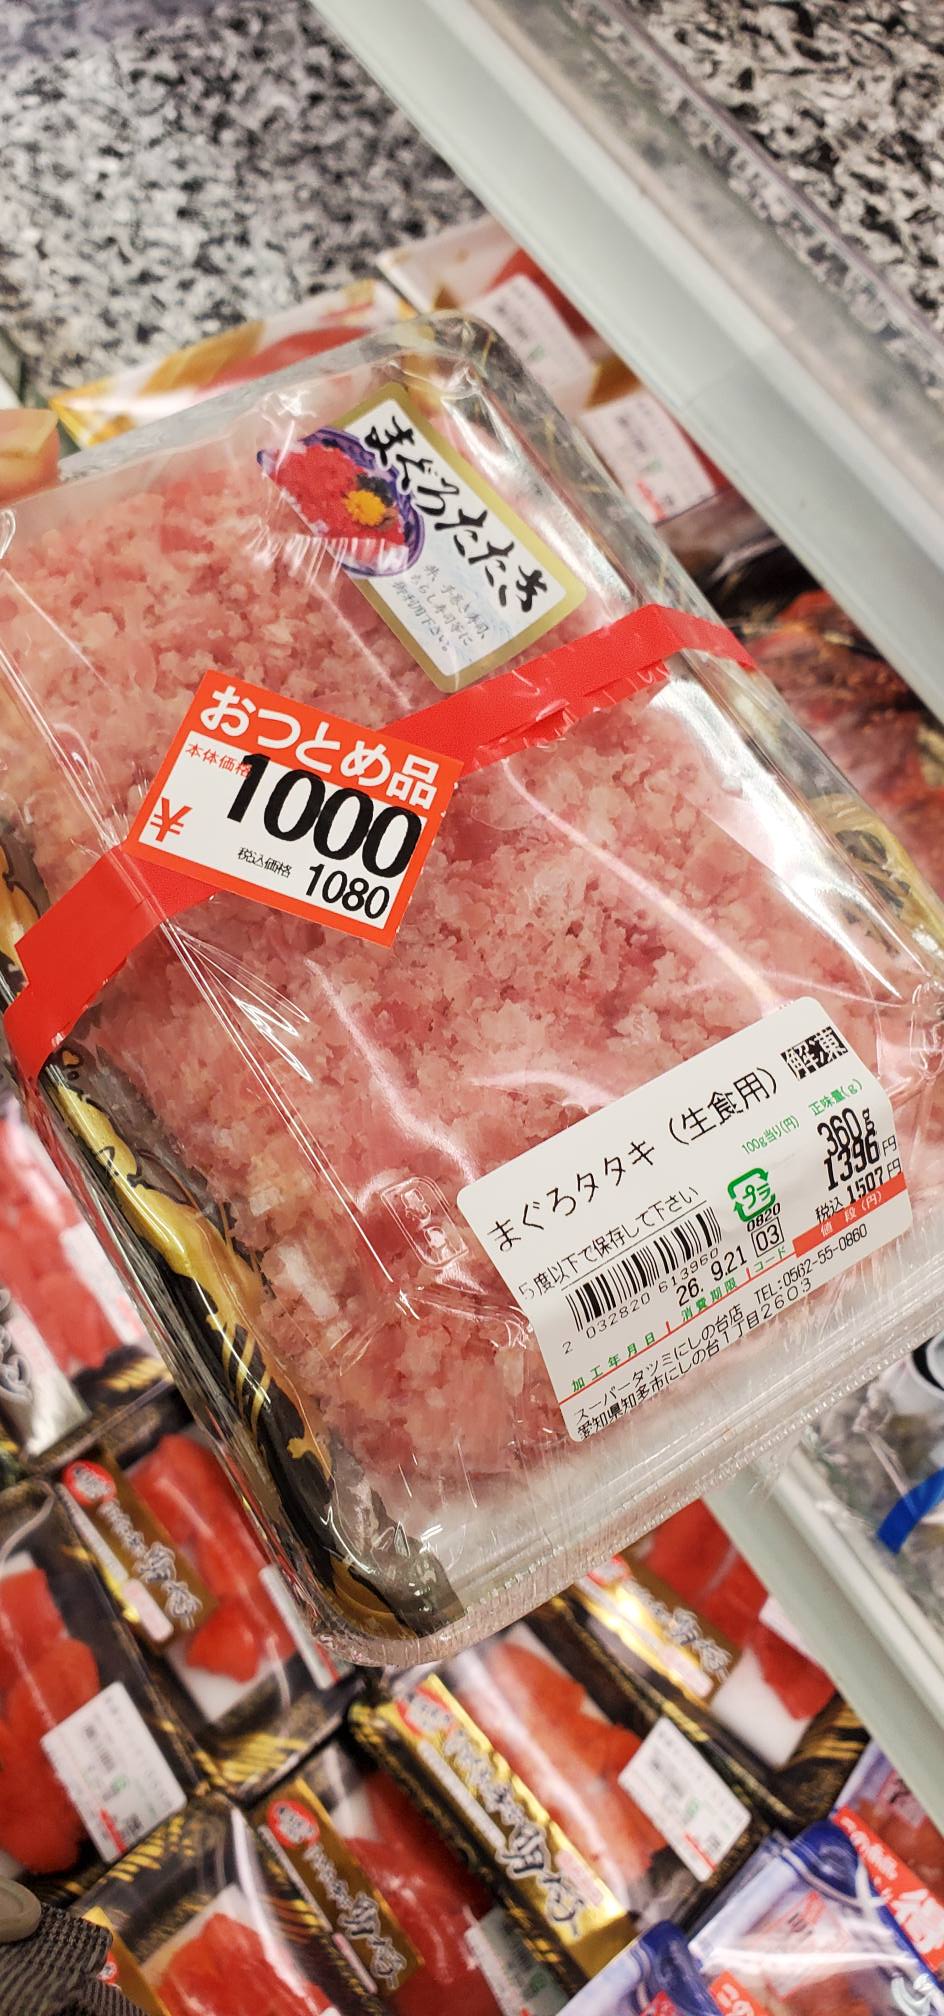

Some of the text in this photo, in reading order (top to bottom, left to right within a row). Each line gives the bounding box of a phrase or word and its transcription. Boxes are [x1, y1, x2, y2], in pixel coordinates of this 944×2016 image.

[365, 416, 548, 613] まぐろたたき
[185, 743, 254, 778] 本体価格
[200, 685, 440, 810] おつとめ品
[149, 753, 423, 878] ¥ 1000
[237, 847, 390, 919] 税込価格 1080
[747, 1203, 781, 1232] 0820
[755, 1224, 780, 1251] 03
[815, 1197, 844, 1224] 税込
[518, 1186, 699, 1300] 5度以下で保存して下さい
[753, 1247, 786, 1273] コード
[562, 1247, 719, 1355] 2 032820 613960
[682, 1277, 737, 1321] 消費期限
[571, 1332, 656, 1393] 加工年月日
